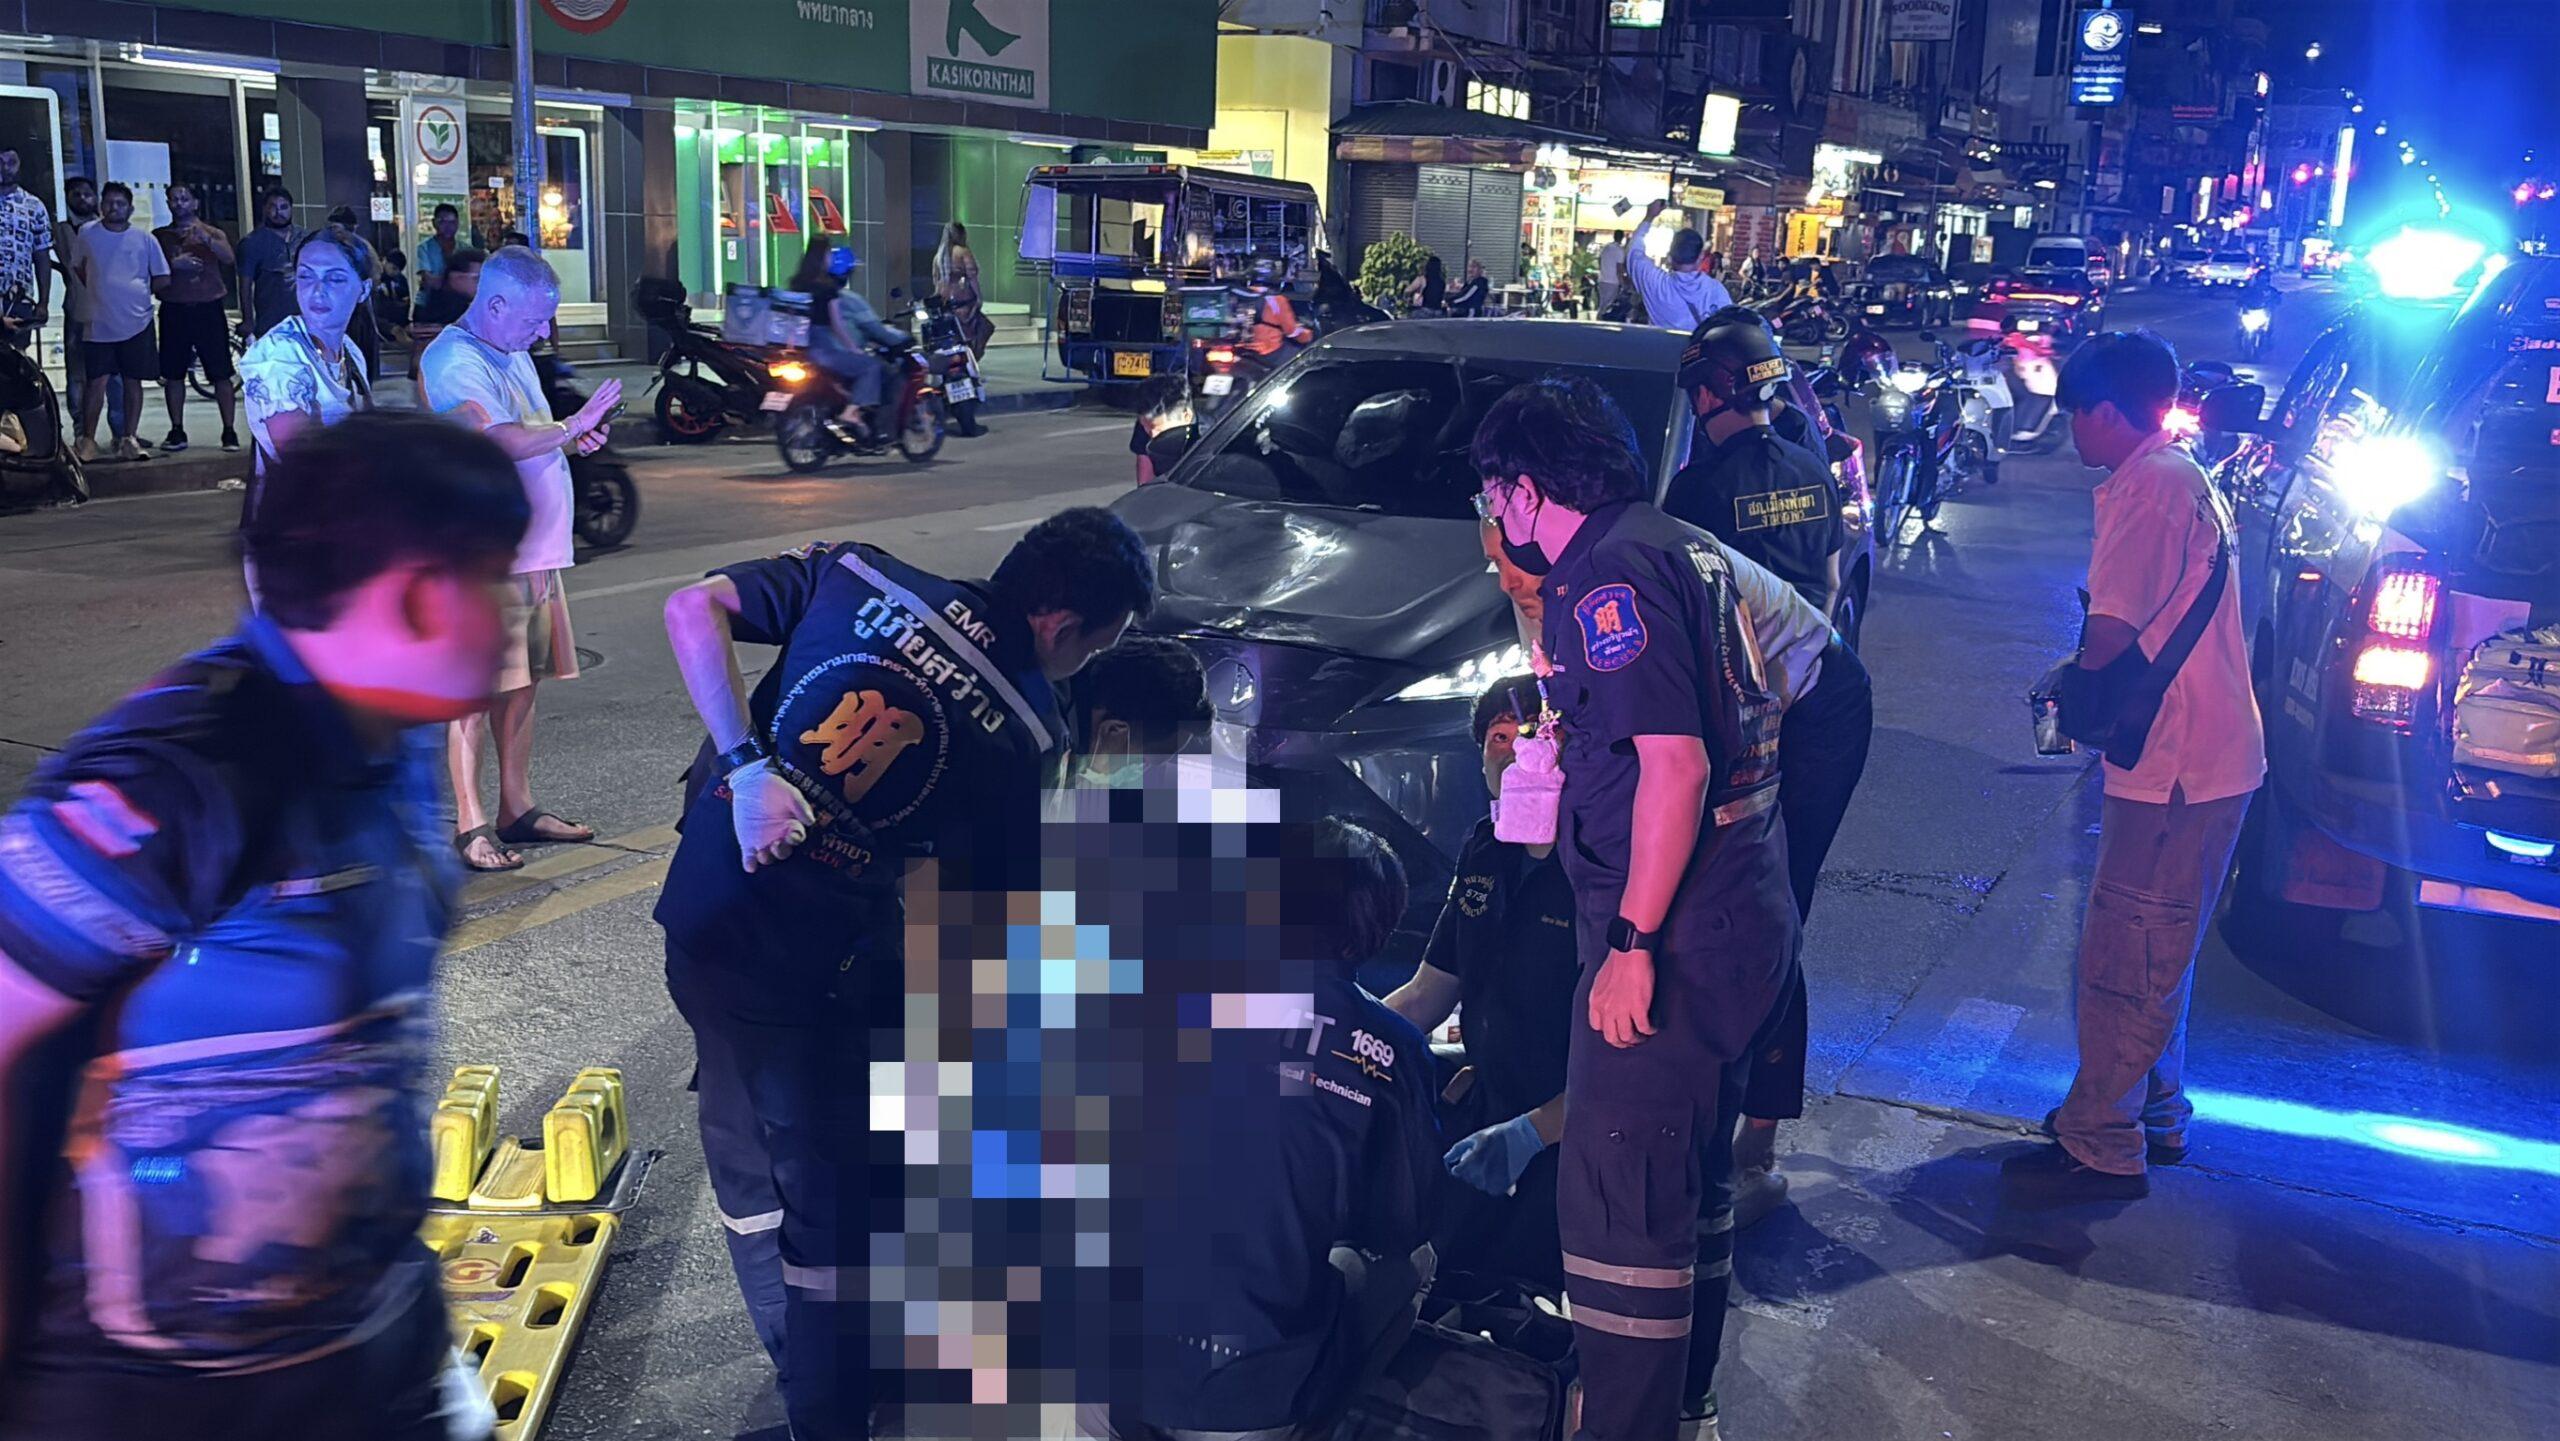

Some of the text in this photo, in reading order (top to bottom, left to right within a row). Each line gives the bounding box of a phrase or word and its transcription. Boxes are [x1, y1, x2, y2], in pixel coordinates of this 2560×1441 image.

[797, 0, 873, 29] พทยากลาง
[931, 64, 1032, 94] KASIKORNTHAI
[944, 599, 996, 650] EMR
[854, 594, 1005, 733] กู้ภัยสว่าง
[1351, 1029, 1395, 1068] 1669
[1309, 1073, 1372, 1107] Technician
